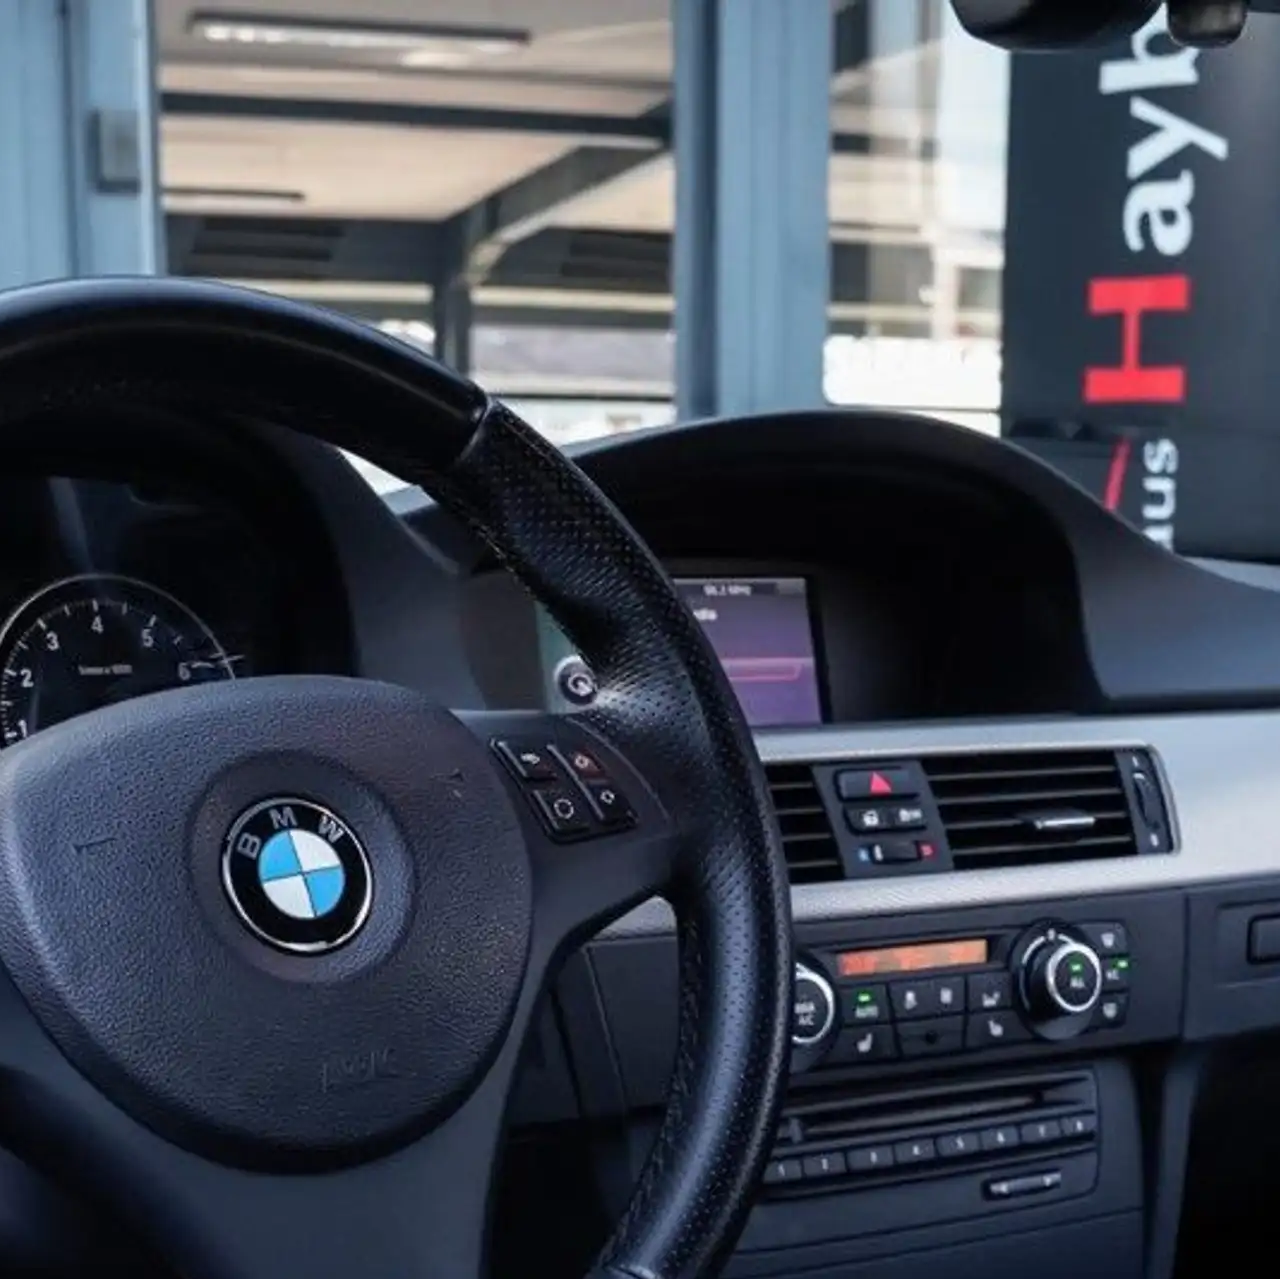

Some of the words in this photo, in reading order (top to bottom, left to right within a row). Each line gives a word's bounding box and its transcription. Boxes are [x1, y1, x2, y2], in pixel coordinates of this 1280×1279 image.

[91, 615, 104, 634] 4
[46, 631, 60, 651] 3
[141, 628, 154, 648] 5
[20, 669, 34, 688] 2
[236, 805, 345, 861] BMW
